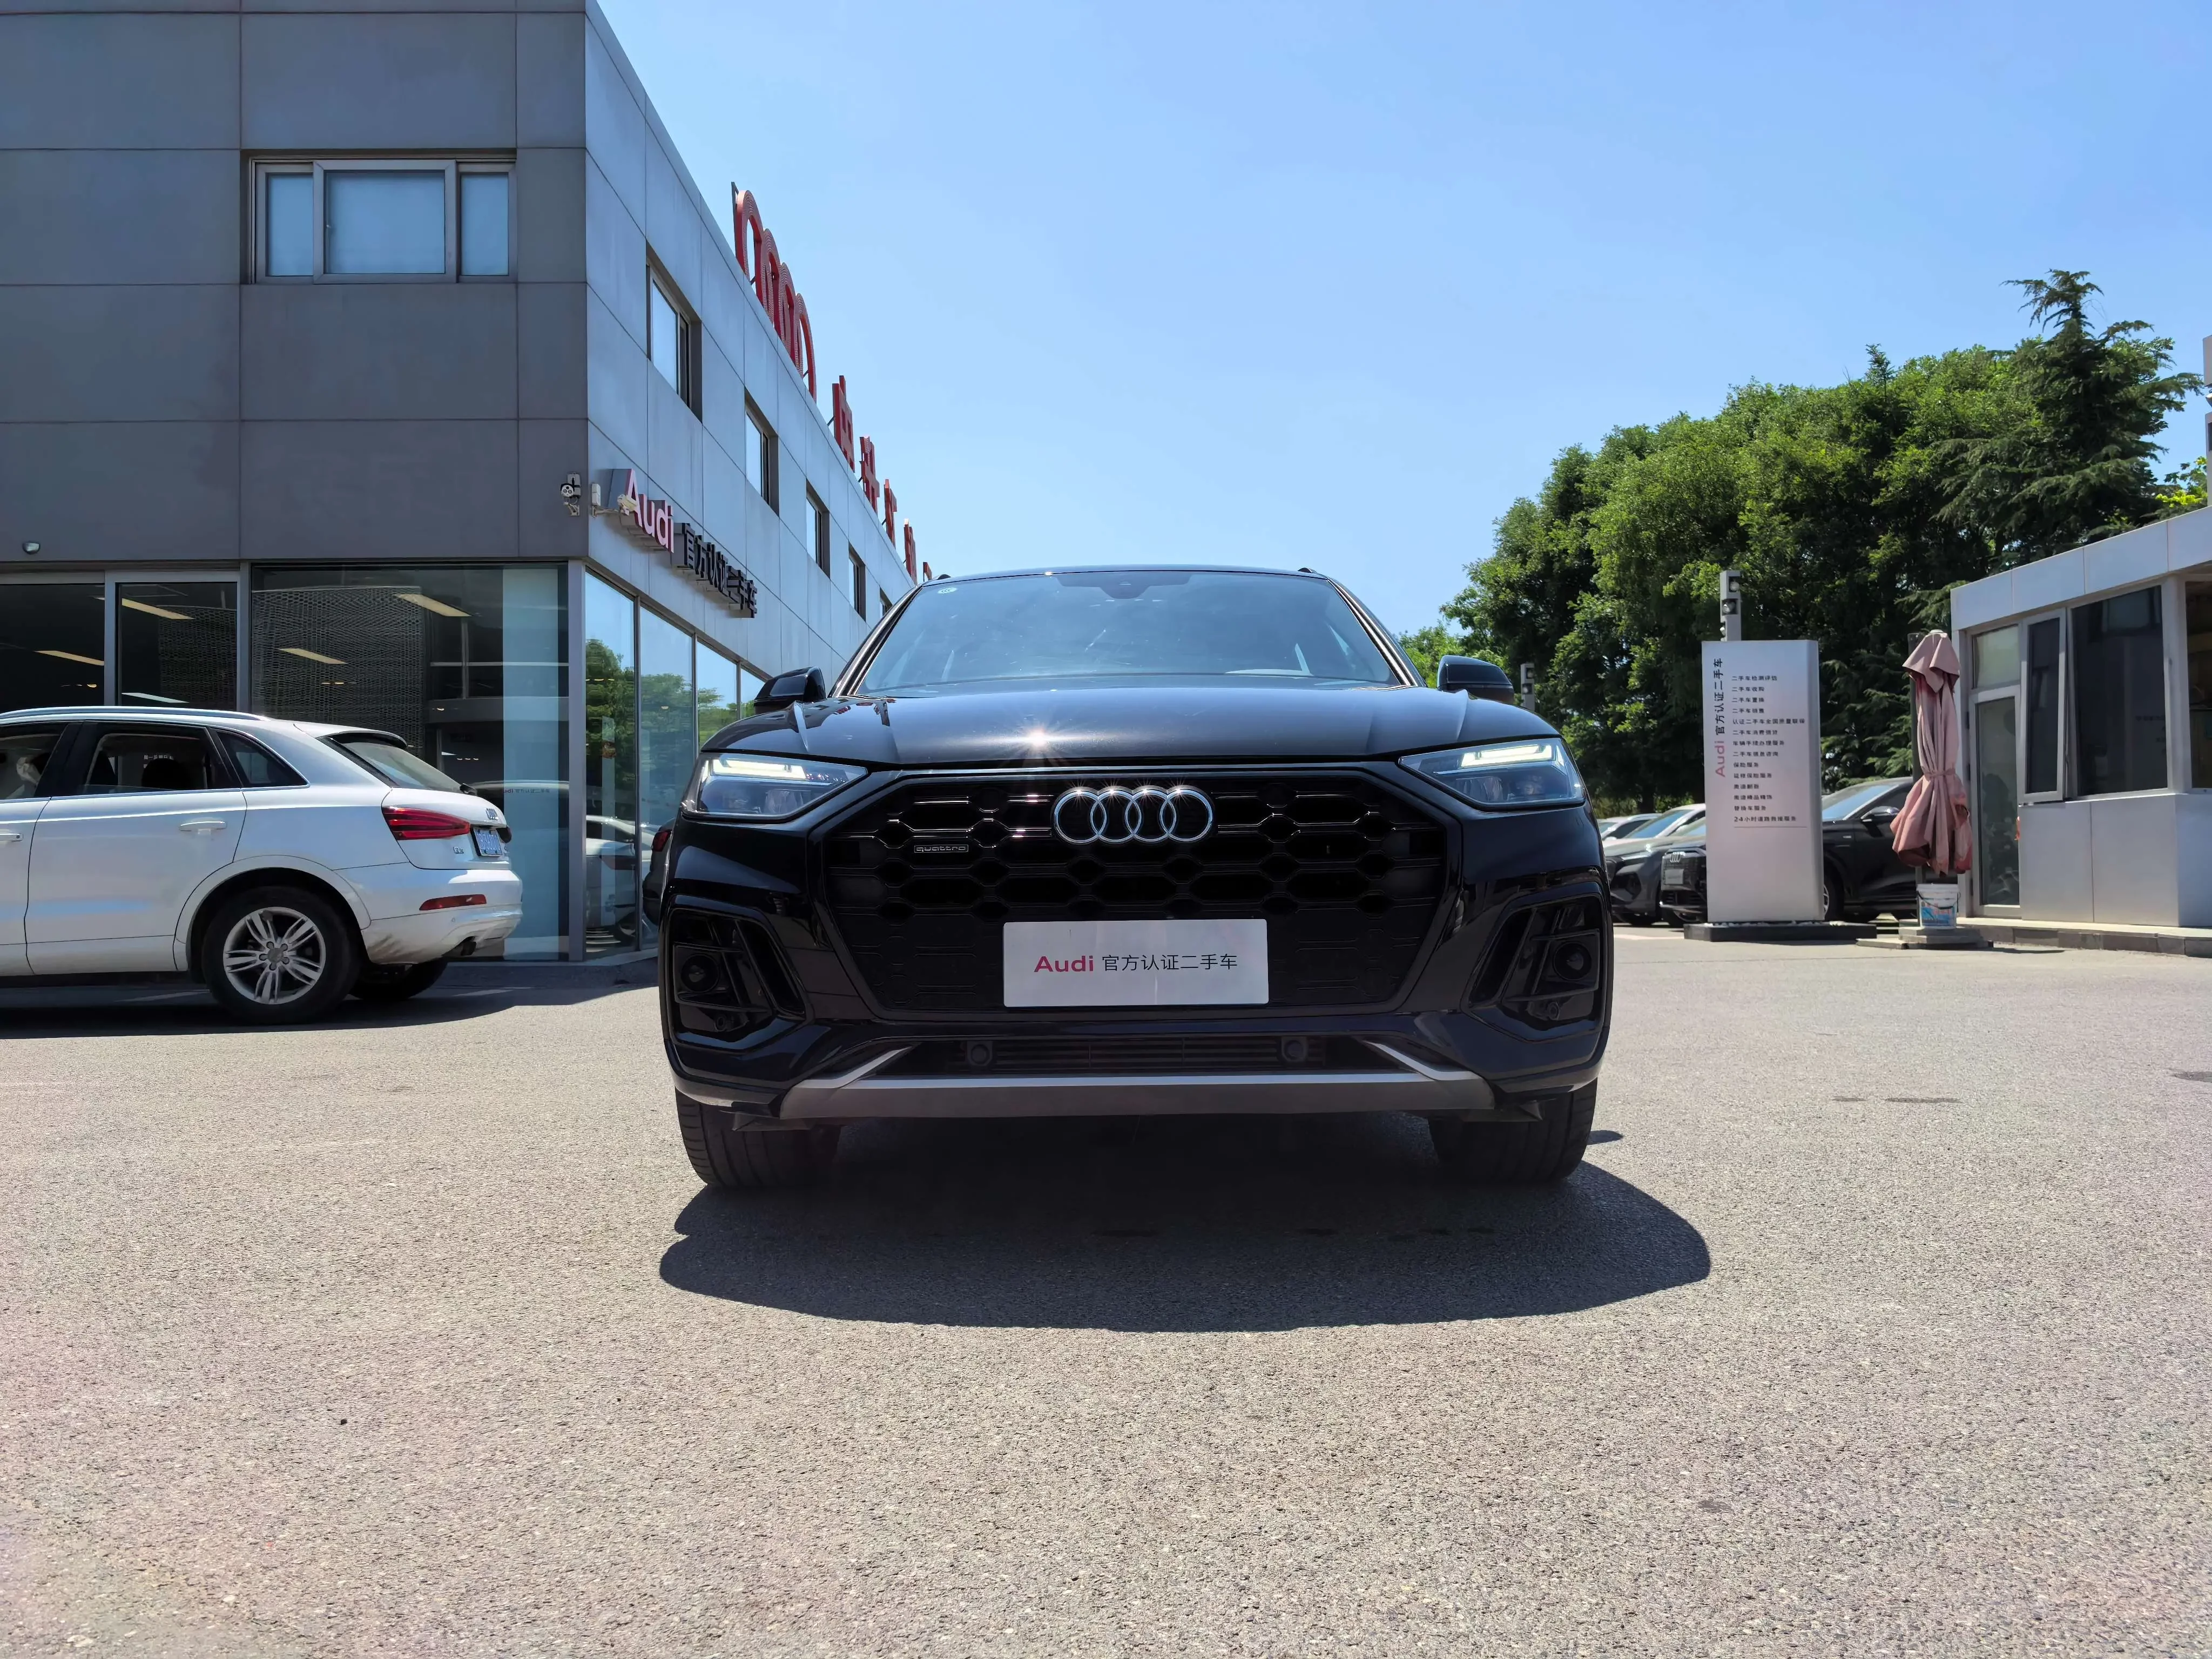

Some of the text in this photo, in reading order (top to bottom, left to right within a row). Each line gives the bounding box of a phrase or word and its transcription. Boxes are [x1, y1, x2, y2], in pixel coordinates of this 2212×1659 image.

[625, 469, 674, 553] Audi
[1714, 658, 1725, 778] Audi 官方认证二手车
[1034, 953, 1238, 973] Audi 官方认证二手车
